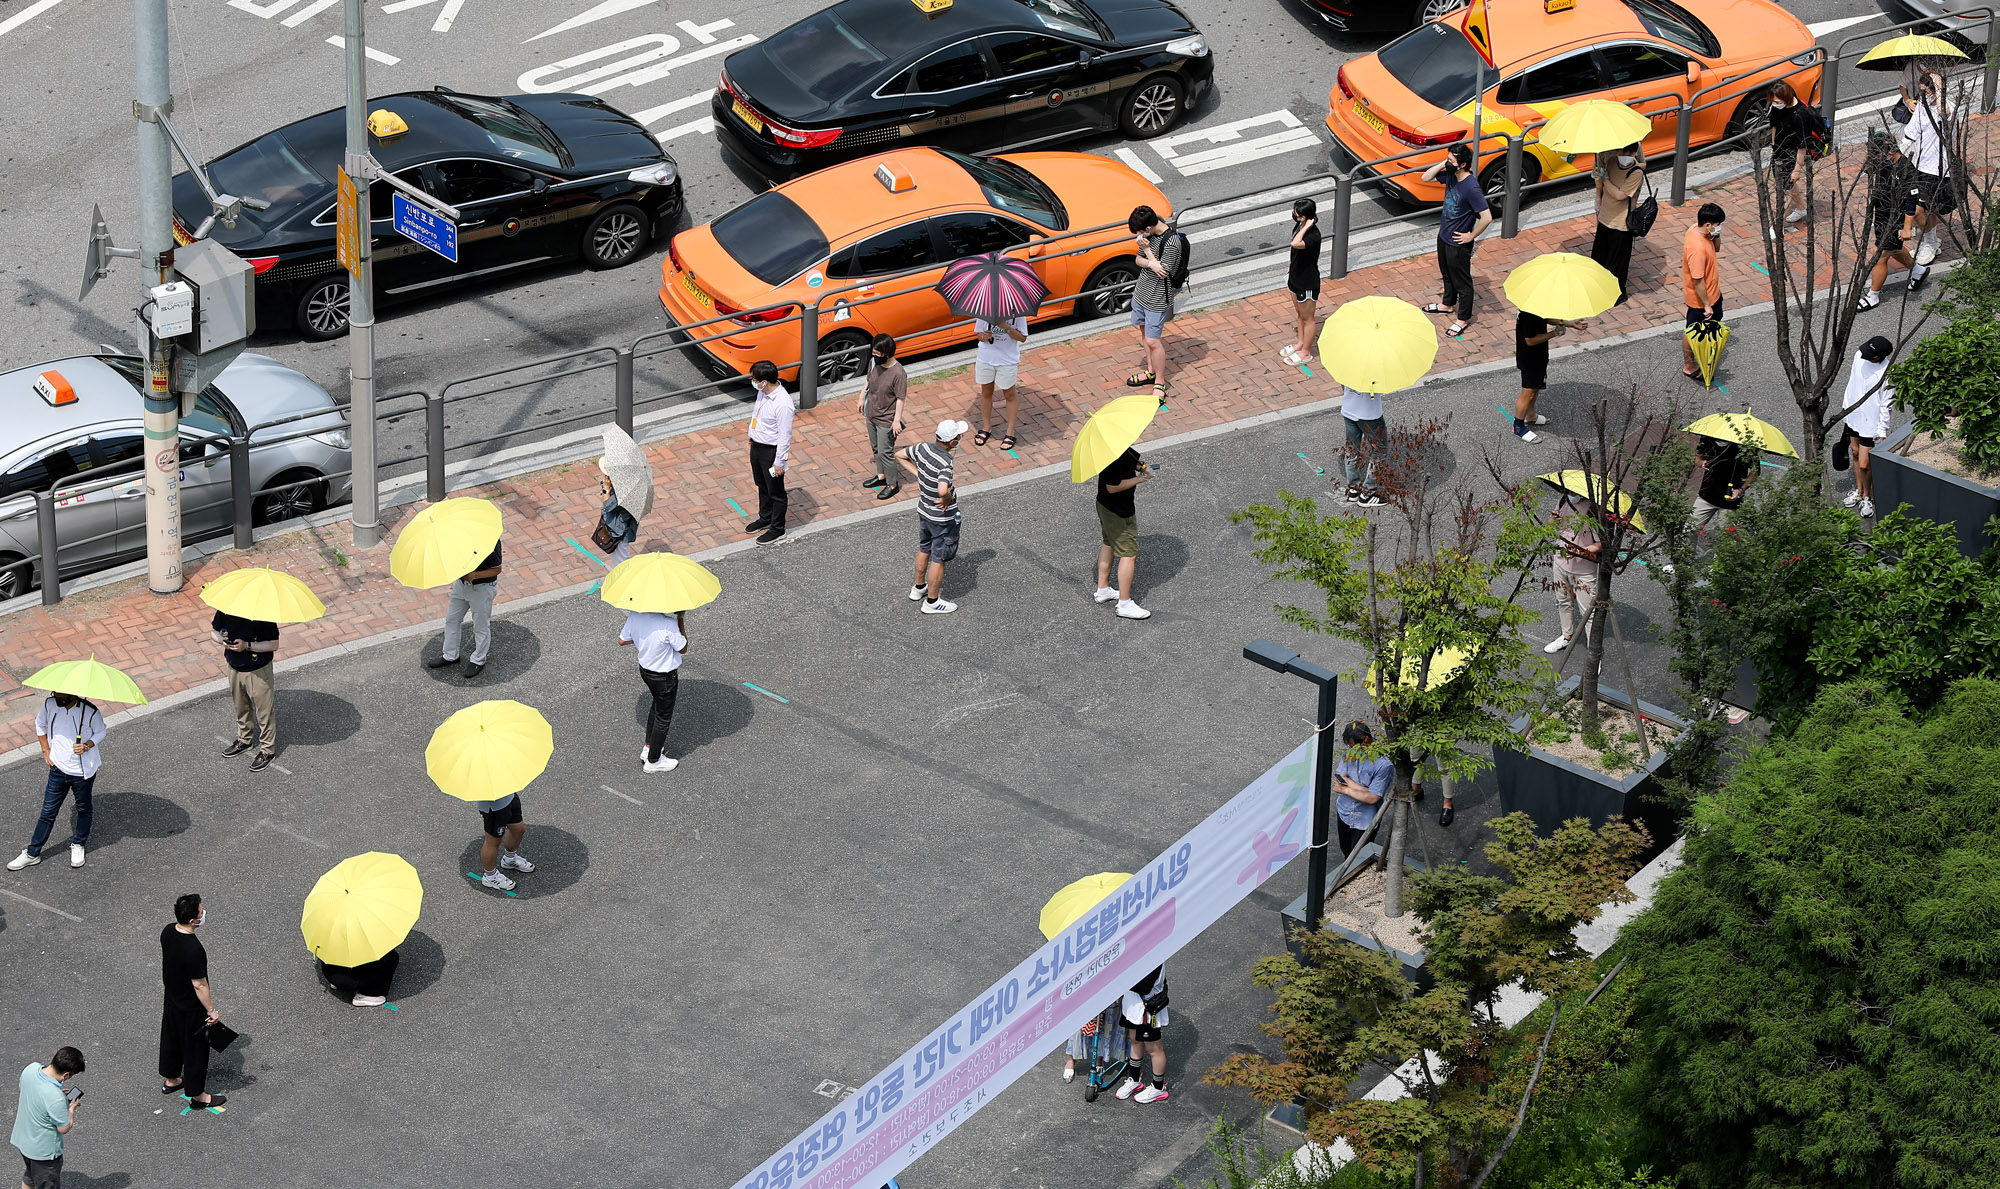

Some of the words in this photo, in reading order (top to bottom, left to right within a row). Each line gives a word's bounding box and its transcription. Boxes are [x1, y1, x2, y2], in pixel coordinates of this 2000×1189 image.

[1368, 114, 1383, 131] 9412
[877, 169, 891, 187] TAXI
[405, 203, 435, 227] 신반포로
[403, 215, 438, 239] Sinbanpo-ro
[38, 380, 51, 398] TAXI
[167, 476, 178, 539] 금연구역
